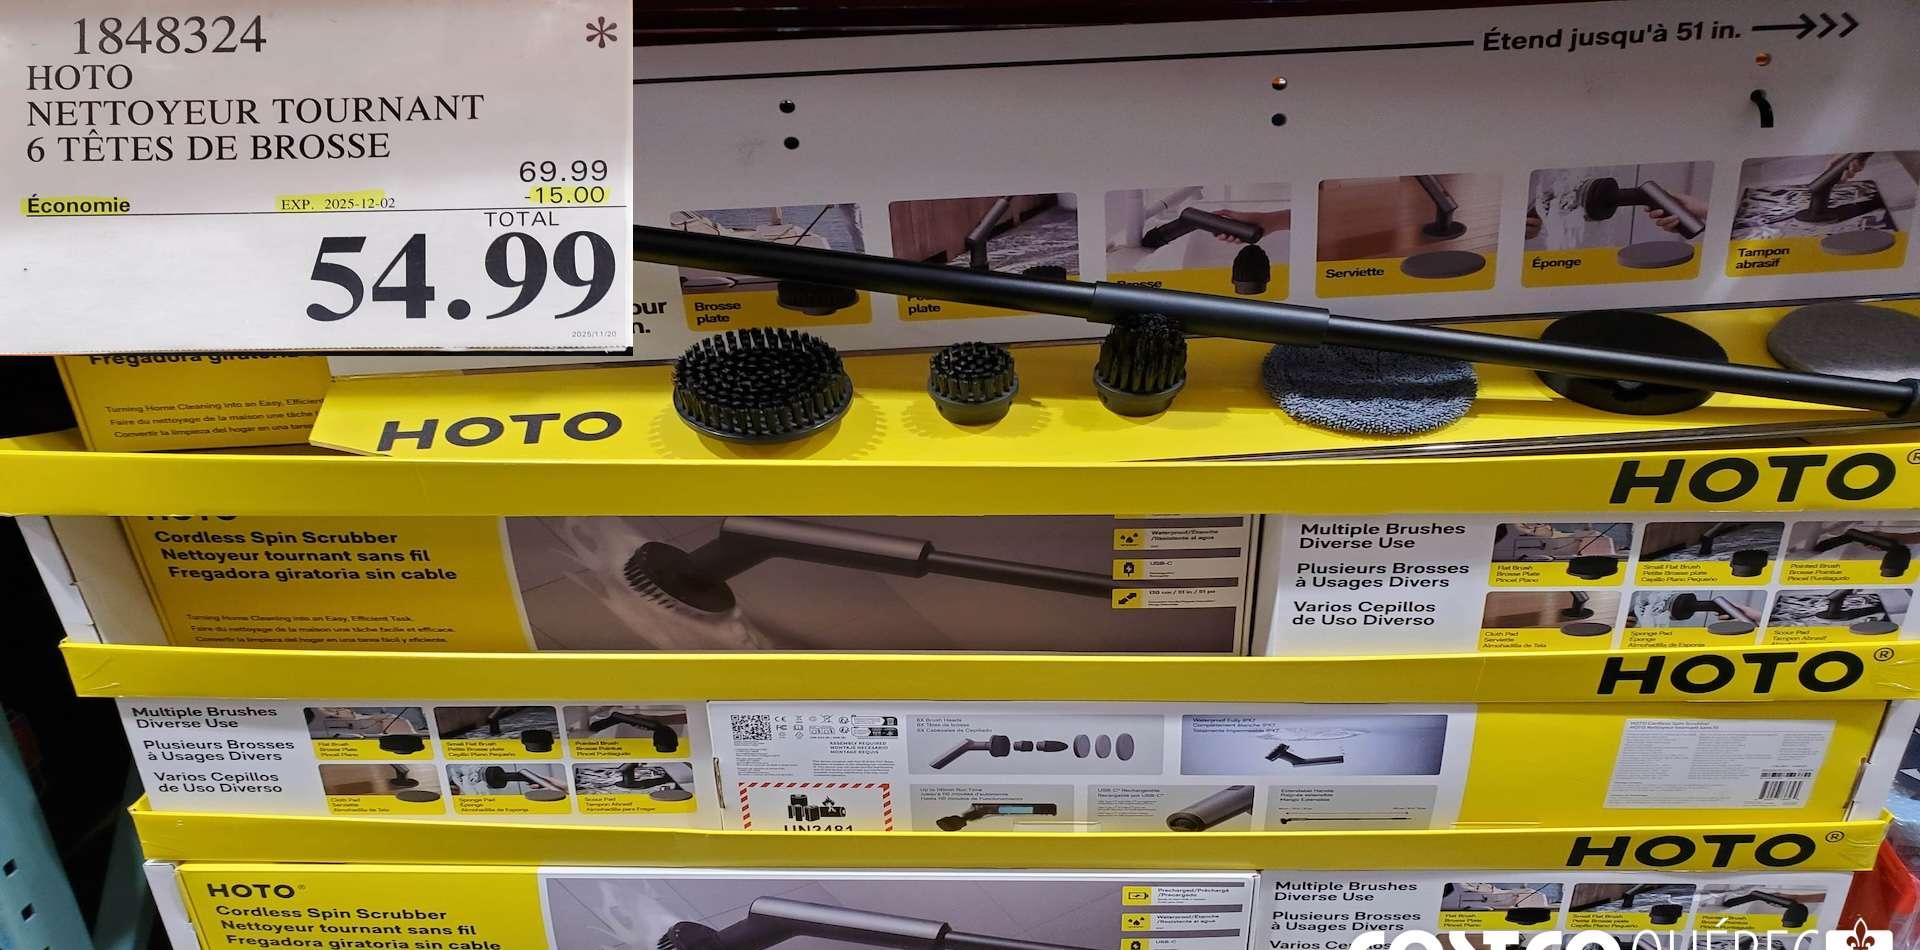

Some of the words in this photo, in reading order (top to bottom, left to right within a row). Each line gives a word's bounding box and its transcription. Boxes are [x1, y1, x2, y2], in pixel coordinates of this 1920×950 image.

[72, 15, 268, 55] 1848324
[1483, 27, 1562, 51] Étend
[1569, 24, 1668, 53] jusqu'à
[1676, 22, 1703, 41] 51
[1711, 21, 1742, 39] in.
[26, 64, 134, 91] HOTO
[26, 98, 261, 127] NETTOYEUR
[272, 94, 486, 124] TOURNANT
[27, 138, 45, 163] 6
[57, 130, 174, 163] TÊTES
[187, 135, 238, 161] DE
[251, 132, 391, 160] BROSSE
[519, 160, 609, 184] 69.99
[27, 194, 131, 214] Économie
[281, 199, 315, 211] EXP.
[324, 197, 397, 210] 2025-12-02
[523, 186, 606, 204] -15.00
[484, 211, 560, 227] TOTAL
[1738, 247, 1790, 259] Tampon
[1532, 256, 1581, 269] Éponge
[1736, 258, 1780, 270] abrasif
[305, 230, 617, 322] 54.99
[1326, 267, 1385, 279] Serviette
[695, 301, 742, 312] Brosse
[909, 304, 941, 316] plate
[696, 314, 730, 325] plate
[376, 411, 623, 451] HOTO
[1609, 452, 1896, 504] HOTO
[1301, 523, 1380, 537] Multiple
[1386, 523, 1466, 535] Brushes
[155, 531, 246, 543] Cordless
[250, 531, 297, 546] Spin
[302, 531, 398, 543] Scrubber
[1300, 537, 1372, 549] Diverse
[1379, 537, 1415, 549] Use
[160, 548, 259, 564] Nettoyeur
[264, 550, 352, 561] tournant
[357, 552, 404, 561] sans
[410, 549, 431, 561] fil
[168, 566, 269, 581] Fregadora
[275, 567, 360, 582] giratoria
[365, 568, 396, 579] sin
[401, 568, 457, 580] cable
[1297, 562, 1387, 574] Plusieurs
[1392, 562, 1470, 574] Brosses
[1295, 576, 1306, 587] à
[1312, 577, 1383, 590] Usages
[1389, 577, 1449, 588] Divers
[1294, 601, 1352, 612] Varios
[1358, 601, 1436, 614] Cepillos
[1292, 615, 1316, 626] de
[1321, 615, 1357, 626] Uso
[1363, 615, 1435, 626] Diverso
[1597, 650, 1865, 695] HOTO
[132, 706, 202, 720] Multiple
[206, 706, 278, 717] Brushes
[136, 718, 201, 729] Diverse
[204, 718, 239, 728] Use
[143, 739, 223, 750] Plusieurs
[227, 740, 294, 750] Brosses
[148, 751, 158, 761] à
[161, 751, 225, 763] Usages
[228, 751, 283, 761] Divers
[154, 771, 207, 782] Varios
[211, 772, 279, 785] Cepillos
[158, 783, 180, 793] de
[183, 783, 215, 793] Uso
[220, 783, 283, 793] Diverso
[1566, 833, 1816, 867] HOTO
[207, 883, 296, 898] HOTO
[1275, 881, 1344, 893] Multiple
[1349, 881, 1418, 891] Brushes
[1274, 891, 1338, 902] Diverse
[1343, 891, 1375, 902] Use
[216, 905, 301, 918] Cordless
[308, 907, 351, 921] Spin
[356, 908, 447, 920] Scrubber
[1272, 911, 1349, 922] Plusieurs
[1354, 911, 1421, 921] Brosses
[221, 920, 314, 934] Nettoyeur
[320, 923, 402, 935] tournant
[407, 925, 453, 935] sans
[457, 925, 477, 936] fil
[1271, 921, 1280, 931] à
[1285, 921, 1350, 933] Usages
[1352, 921, 1405, 932] Divers
[227, 935, 323, 950] Fregadora
[329, 939, 408, 950] giratoria
[415, 940, 442, 950] sin
[448, 940, 501, 950] cable
[1270, 940, 1320, 950] Varios
